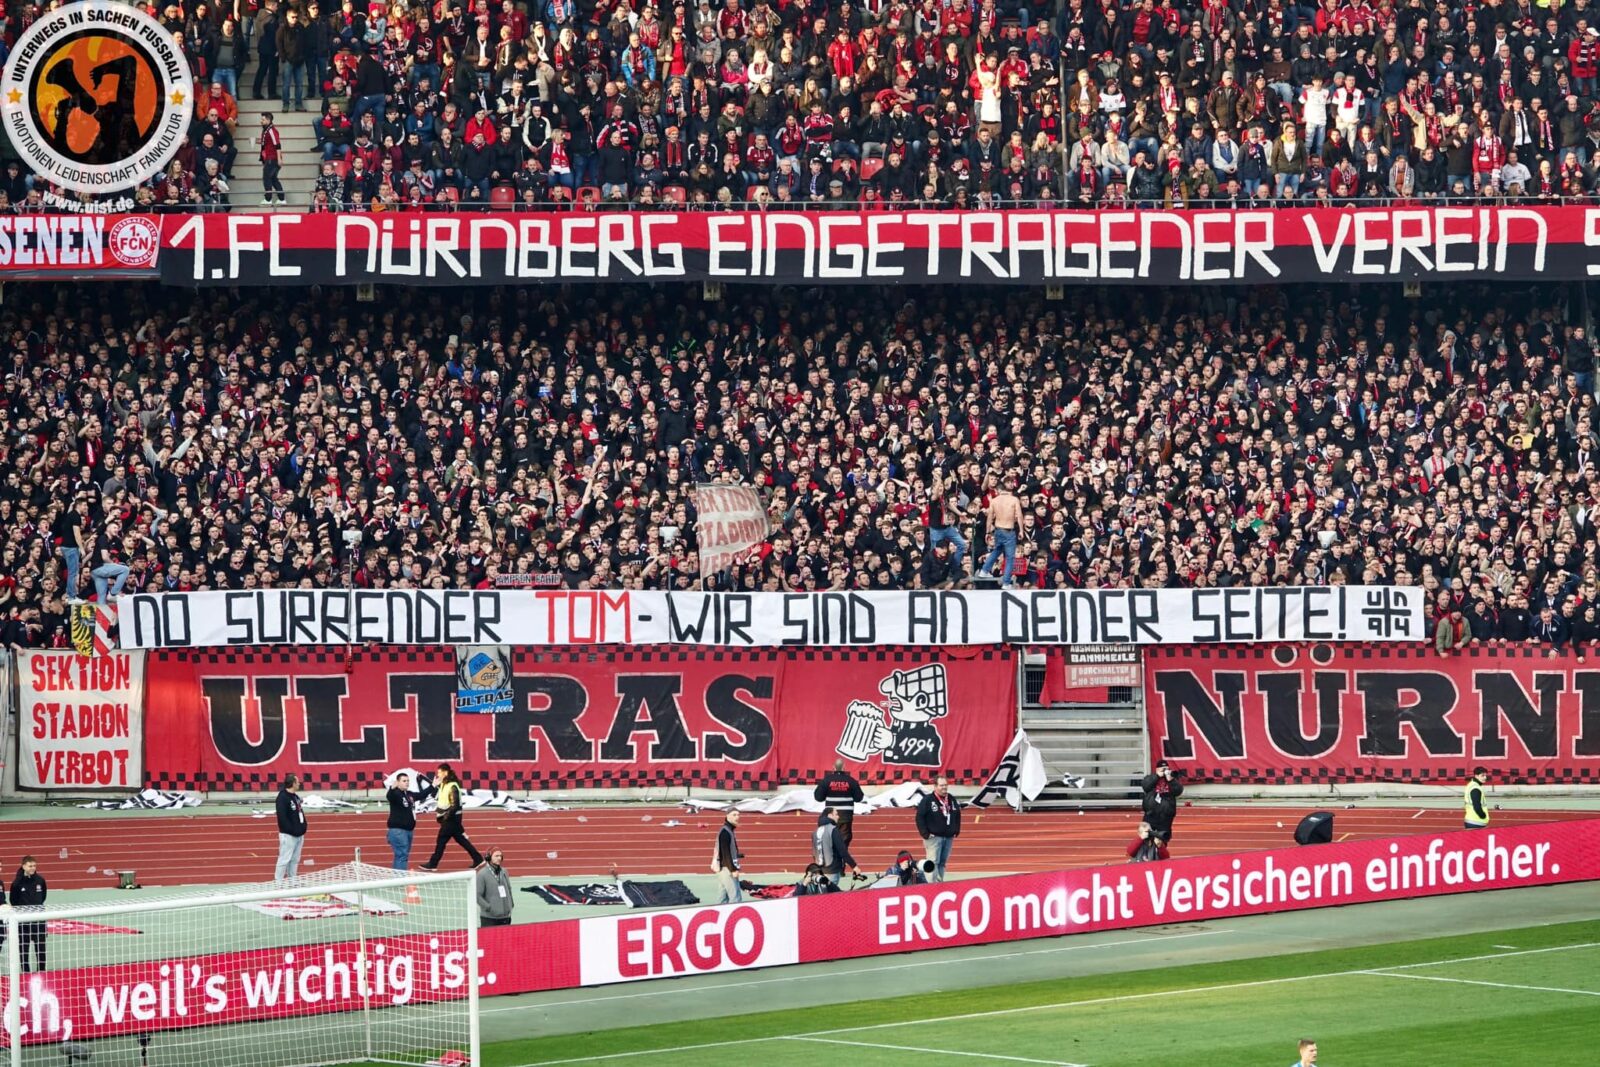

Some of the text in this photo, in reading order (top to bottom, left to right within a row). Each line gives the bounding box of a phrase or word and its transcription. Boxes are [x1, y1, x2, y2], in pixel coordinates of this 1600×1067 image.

[120, 237, 149, 250] FCN
[334, 213, 686, 279] NÜRNBERG
[707, 212, 1282, 281] EINGETRAGENER
[1302, 208, 1547, 274] VEREIN
[133, 594, 191, 647] NO
[226, 590, 502, 645] SURRENDER
[535, 590, 632, 643] TOM
[665, 592, 754, 644] WIR
[783, 593, 876, 645] SIND
[908, 591, 969, 644] AN
[1001, 590, 1163, 643] DEINER
[1193, 588, 1347, 641] SEITE!
[31, 653, 130, 692] SEKTION
[1071, 653, 1136, 663] BANNMEILE
[456, 688, 515, 708] ULTRAS
[33, 703, 129, 739] STADION
[201, 672, 775, 765] ULTRAS
[899, 737, 935, 756] 1994
[34, 750, 129, 786] VERBOT
[877, 833, 1561, 945] ERGO macht Versichern einfacher.
[618, 906, 764, 978] ERGO
[241, 949, 413, 1008] wichtig
[430, 938, 497, 989] ist.
